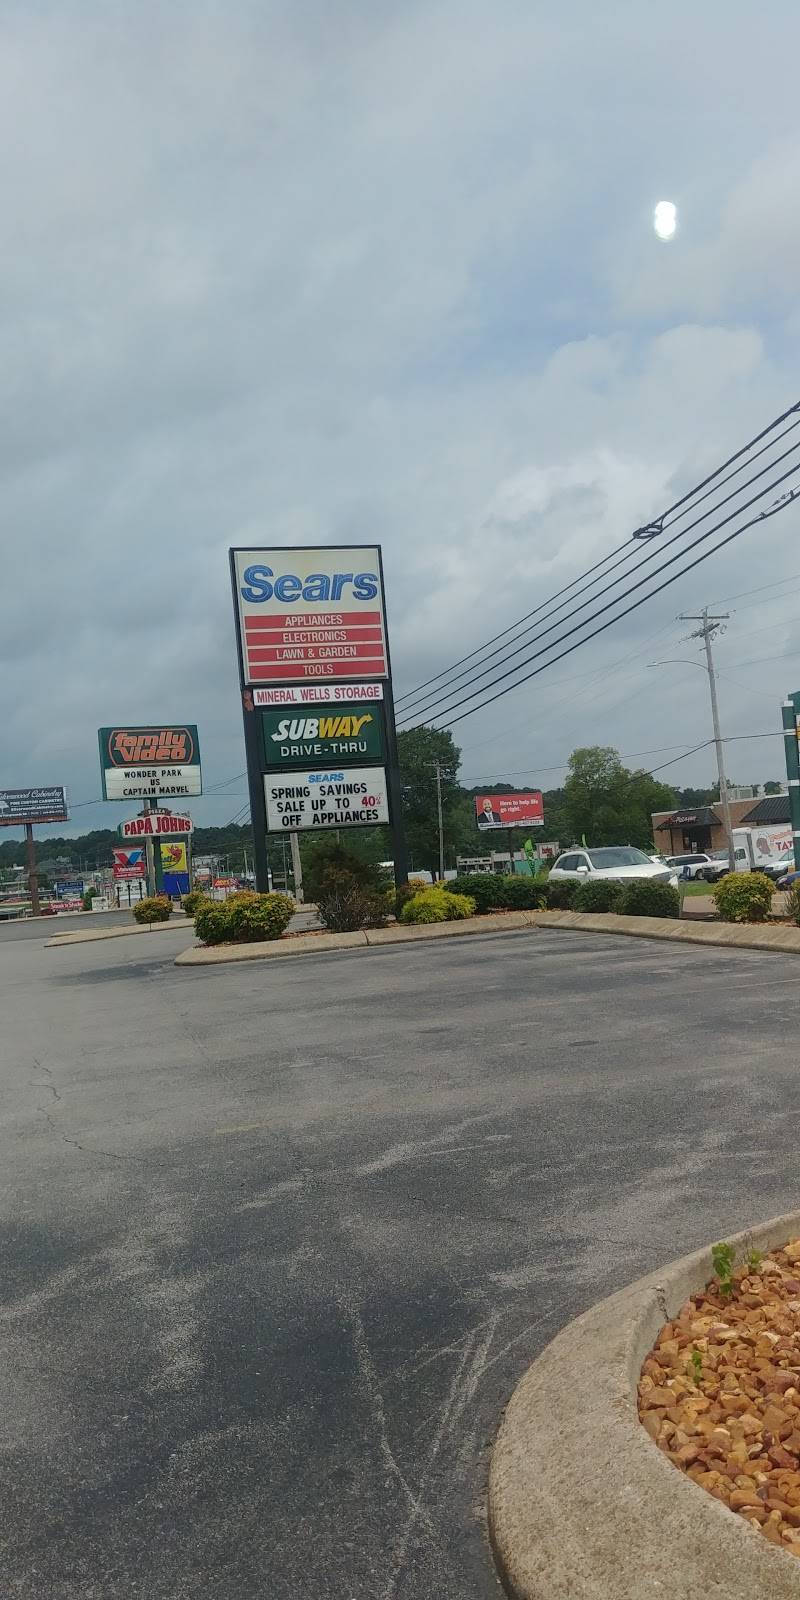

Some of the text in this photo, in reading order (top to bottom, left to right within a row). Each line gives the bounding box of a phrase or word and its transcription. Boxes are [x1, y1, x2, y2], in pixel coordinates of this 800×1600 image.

[240, 564, 378, 603] Sears
[284, 614, 343, 627] APPLIANCES
[282, 630, 347, 643] ELECTRONICS
[276, 646, 357, 660] LAWN & GARDEN
[303, 664, 334, 675] TOOLS
[256, 686, 380, 703] MINERAL WELLS STORAGE
[271, 713, 373, 741] SUBWAY
[280, 741, 367, 757] DRIVE-THRU
[124, 769, 182, 779] WONDER PARK
[308, 772, 345, 784] SEARS
[150, 778, 161, 786] US
[123, 785, 189, 796] CAPTAIN MARVEL
[271, 783, 368, 799] SPRING SAVINGS
[277, 800, 305, 813] SALE
[311, 800, 326, 810] UP
[335, 798, 350, 808] TO
[282, 809, 379, 827] OFF APPLIANCES
[124, 816, 191, 836] PAPA JOHNS
